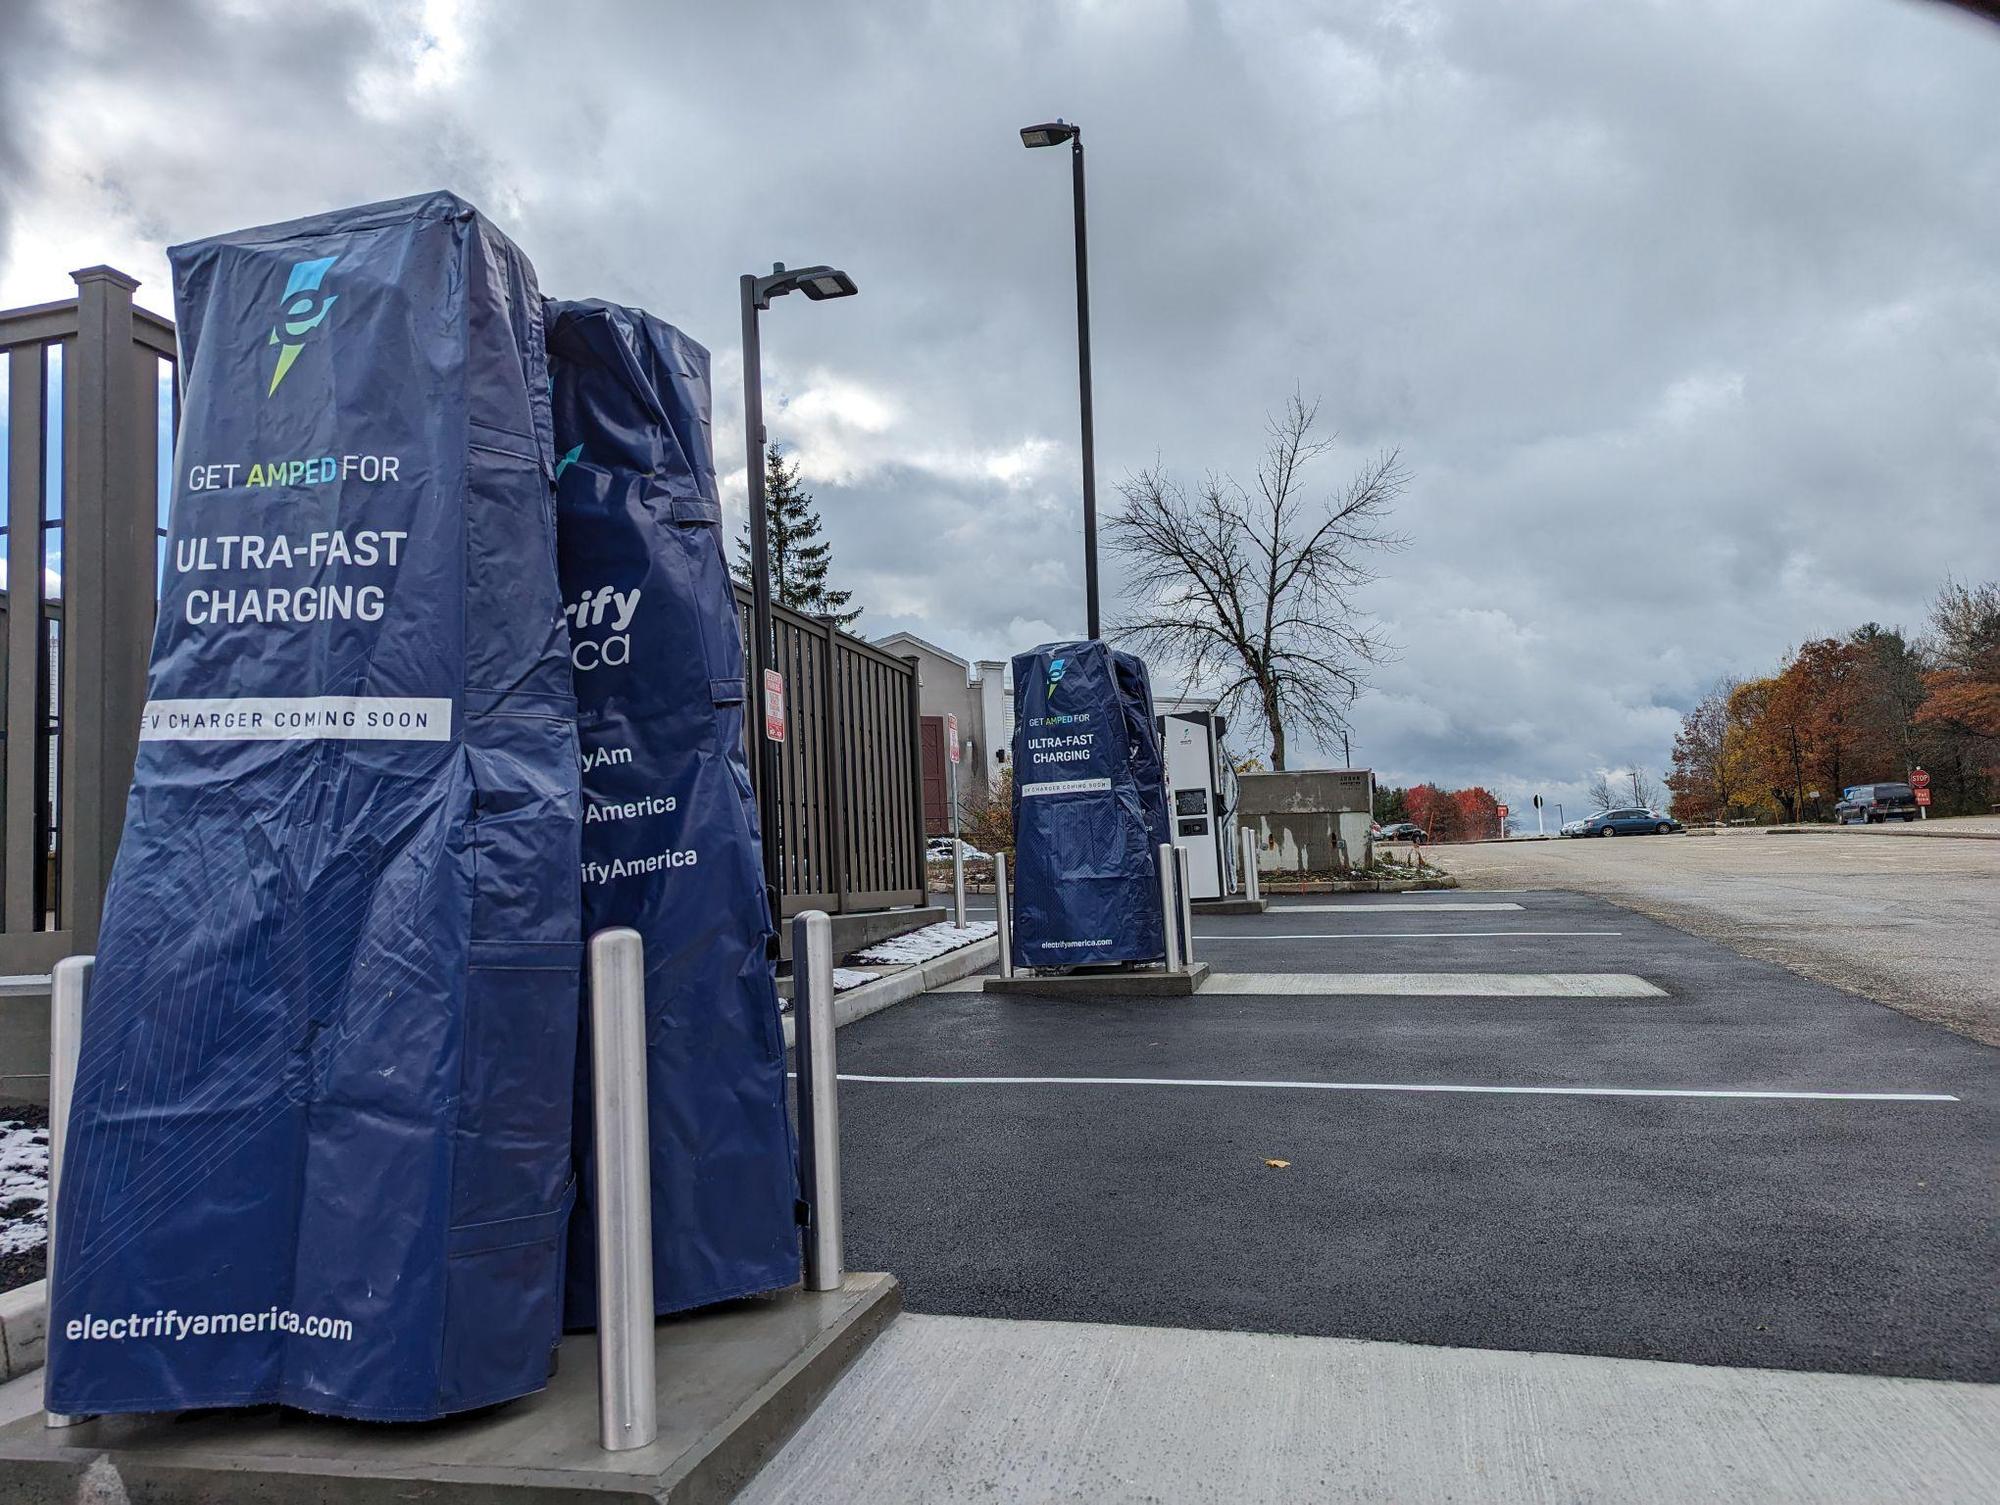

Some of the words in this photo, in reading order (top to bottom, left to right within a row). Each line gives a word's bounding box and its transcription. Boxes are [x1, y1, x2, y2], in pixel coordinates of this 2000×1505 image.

[189, 464, 241, 491] GET
[246, 457, 337, 488] AMPED
[342, 455, 400, 482] FOR
[176, 530, 408, 573] ULTRA-FAST
[185, 585, 385, 625] CHARGING
[169, 712, 263, 729] CHARGER
[274, 711, 356, 729] COMING
[367, 711, 428, 728] SOON
[1029, 717, 1045, 727] GET
[1045, 715, 1073, 726] AMPED
[1074, 713, 1090, 723] FOR
[1028, 734, 1094, 750] ULTRA-FAST
[1033, 750, 1091, 764] CHARGING
[1912, 774, 1928, 782] STOP
[582, 796, 677, 824] America
[580, 849, 698, 885] ifyAmerica
[1041, 938, 1113, 949] electrifyamerica.com
[66, 1306, 353, 1341] electrifyamerica.com
